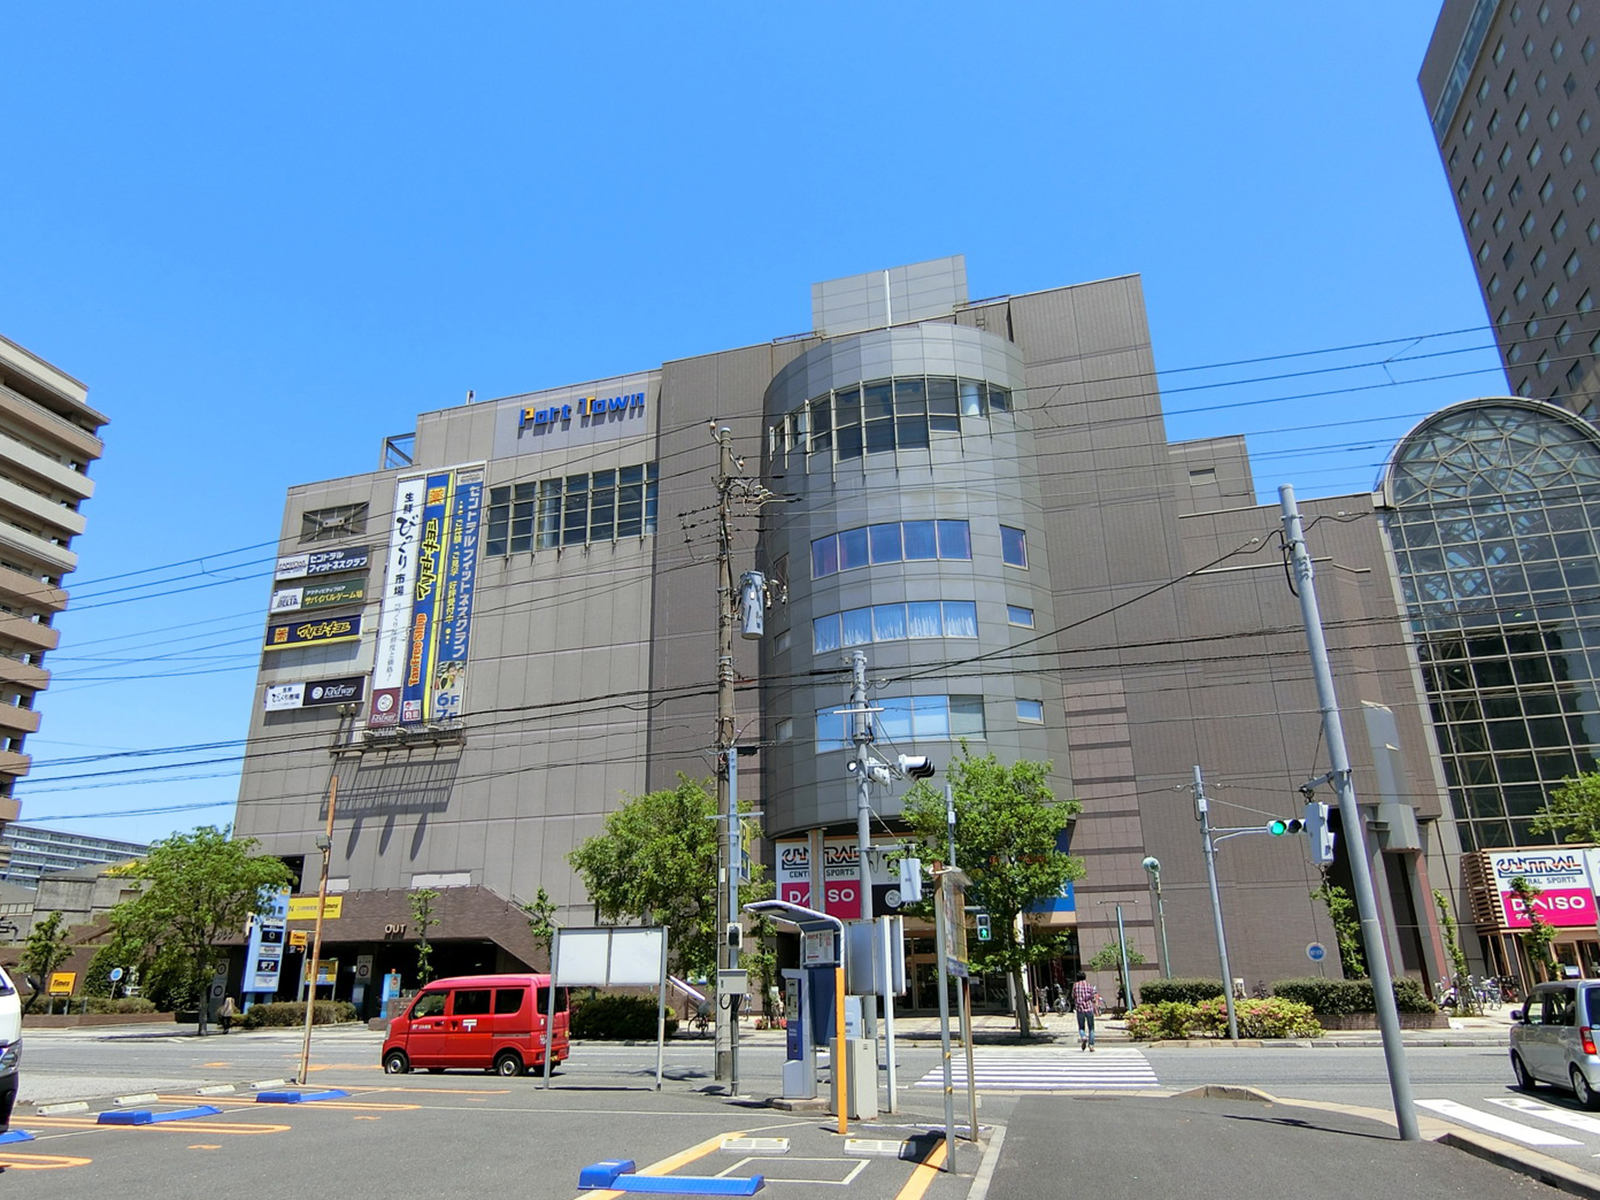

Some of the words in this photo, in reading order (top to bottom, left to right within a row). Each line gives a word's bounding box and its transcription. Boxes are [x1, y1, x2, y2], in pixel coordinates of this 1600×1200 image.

[519, 404, 572, 428] Port
[578, 392, 645, 416] Town
[308, 556, 368, 573] フィットネスクラブ
[310, 551, 345, 564] セントラル
[416, 518, 440, 601] マツモトキヨシ
[297, 621, 351, 639] マツモトキヨシ
[413, 613, 428, 641] Shop
[410, 641, 424, 666] Free
[408, 666, 420, 687] Tax
[437, 692, 460, 706] 6F
[826, 868, 855, 877] SPORTS
[384, 923, 406, 934] OUT
